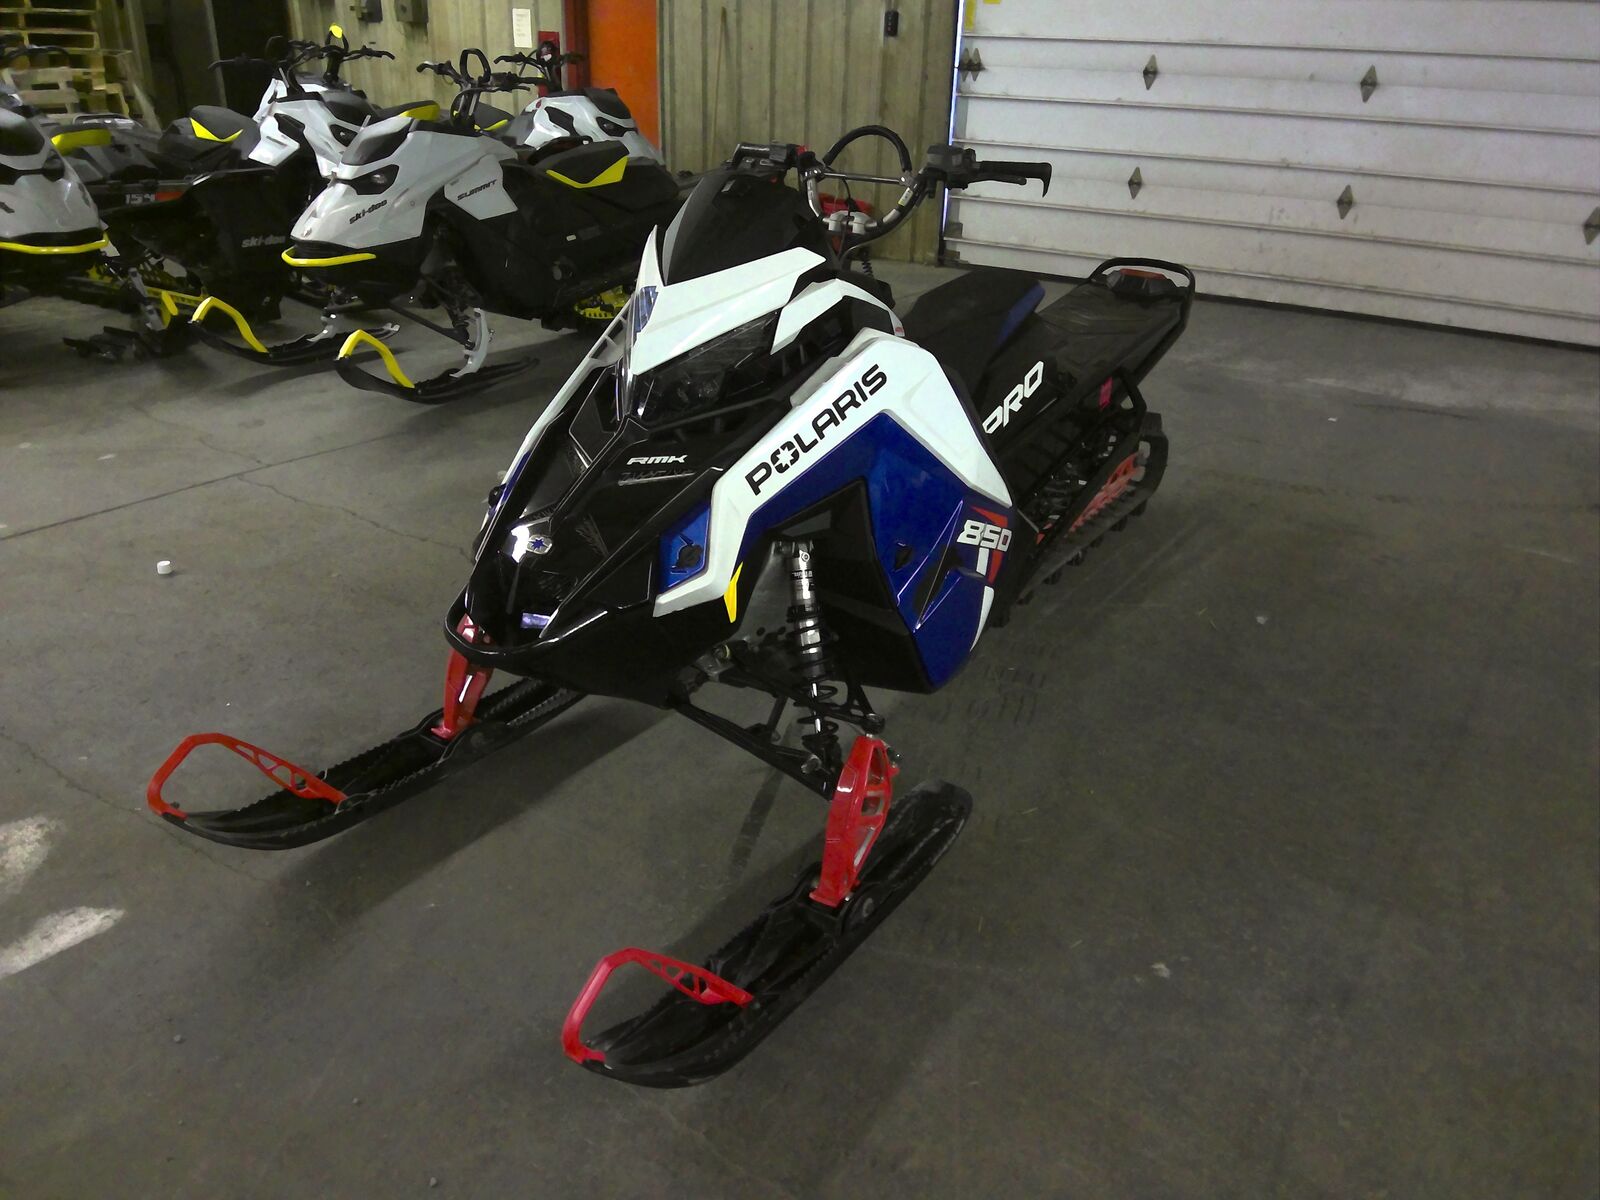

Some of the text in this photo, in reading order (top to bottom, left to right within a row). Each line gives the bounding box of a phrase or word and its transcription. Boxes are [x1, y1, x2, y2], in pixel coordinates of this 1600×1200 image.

[457, 179, 497, 201] SUMMIT
[982, 360, 1044, 434] PRO
[744, 363, 887, 496] POLARIS
[626, 454, 688, 466] RMK
[956, 519, 1012, 552] 850
